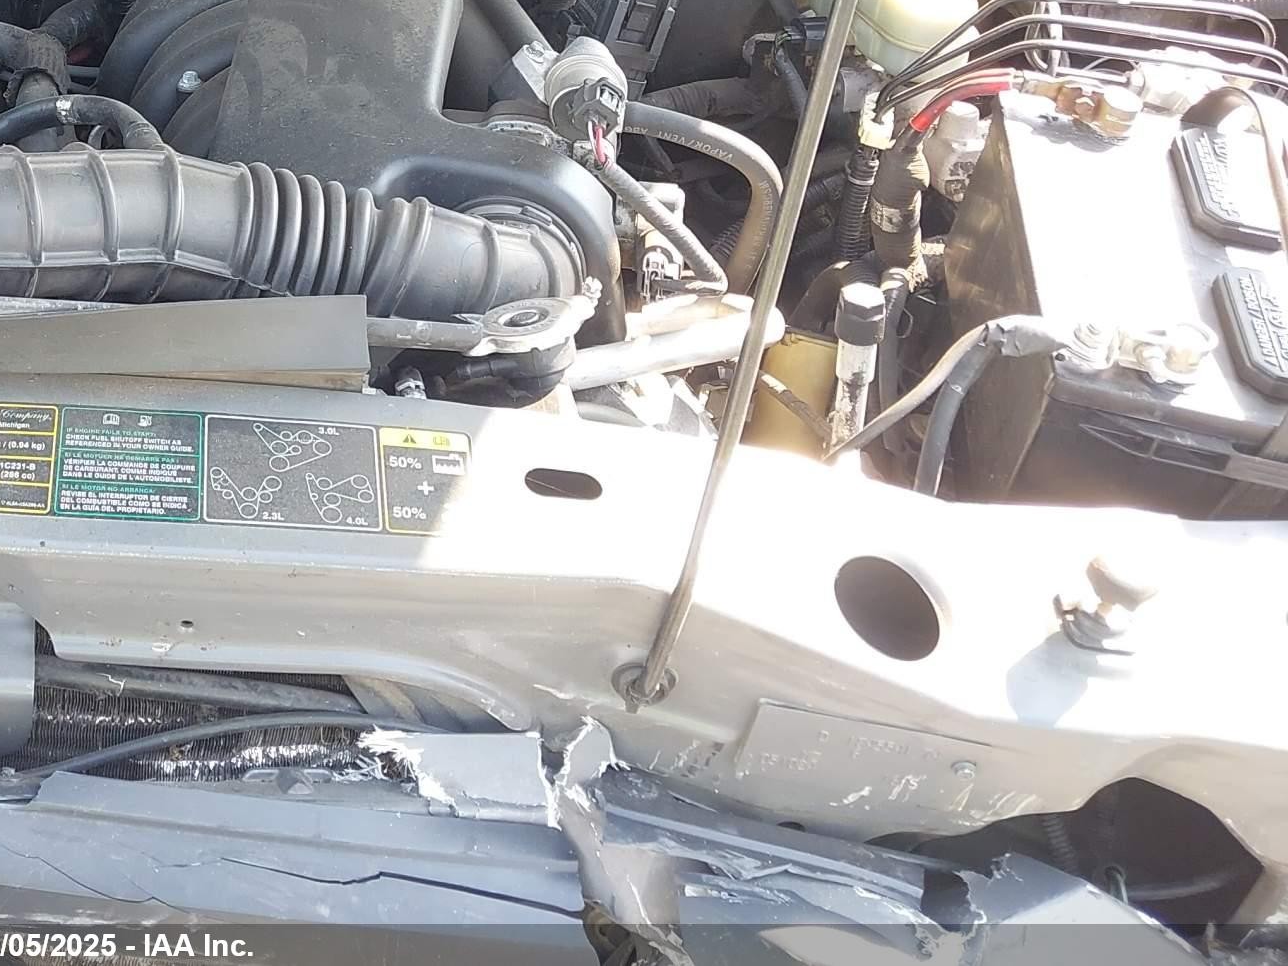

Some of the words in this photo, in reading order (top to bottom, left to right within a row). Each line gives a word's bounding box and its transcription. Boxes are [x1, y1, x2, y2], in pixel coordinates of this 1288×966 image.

[0, 422, 30, 430] Michigan
[317, 426, 340, 436] 3.0L
[65, 433, 90, 441] CHECK
[31, 441, 46, 451] kg)
[65, 439, 112, 448] REFERENCED
[121, 442, 142, 450] YOUR
[389, 455, 422, 470] 50%
[94, 472, 117, 480] GUIDE
[262, 511, 284, 521] 2.3L
[392, 505, 427, 520] 50%
[346, 516, 369, 526] 4.0L
